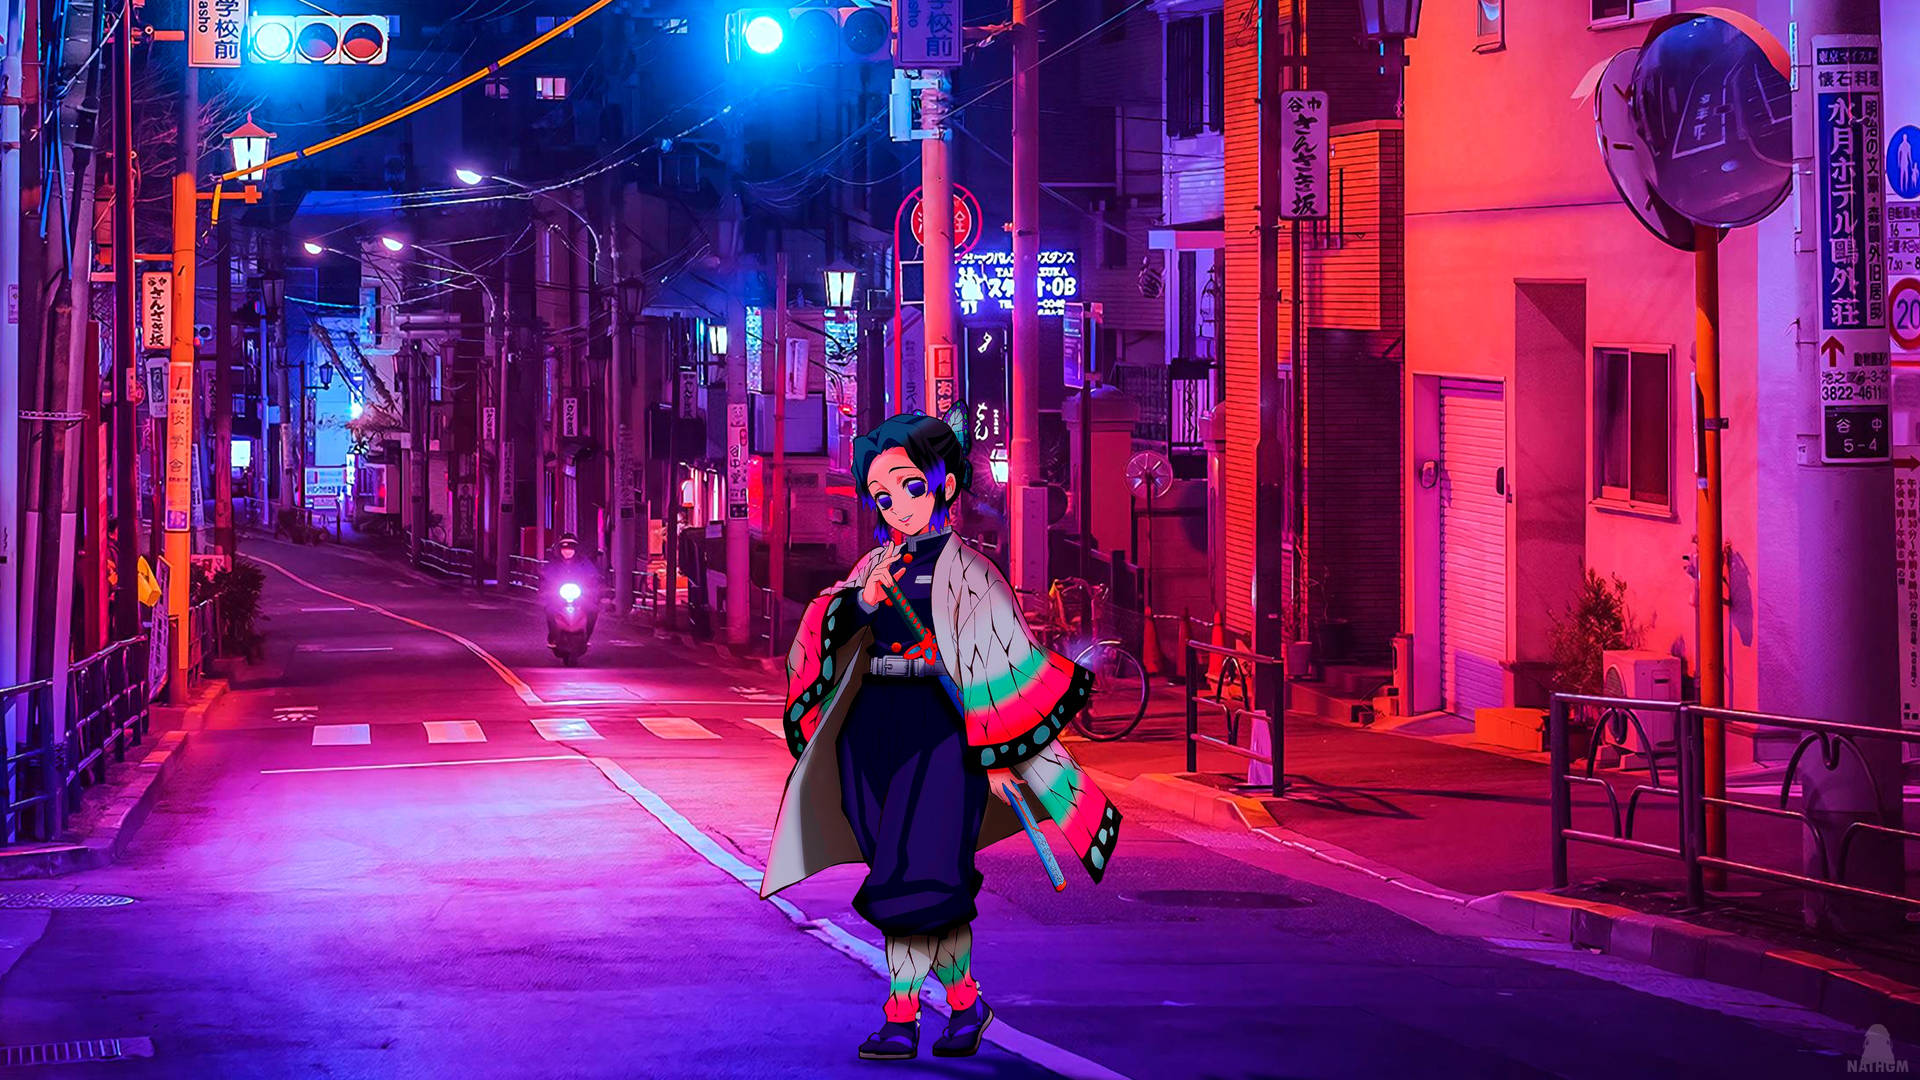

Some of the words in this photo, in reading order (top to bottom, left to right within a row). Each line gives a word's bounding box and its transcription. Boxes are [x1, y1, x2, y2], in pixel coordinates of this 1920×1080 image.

[215, 0, 239, 60] 学校前
[1818, 71, 1880, 86] 懐石料理
[1897, 298, 1920, 330] 20
[1836, 418, 1882, 434] 谷中
[1844, 438, 1878, 454] 5-4
